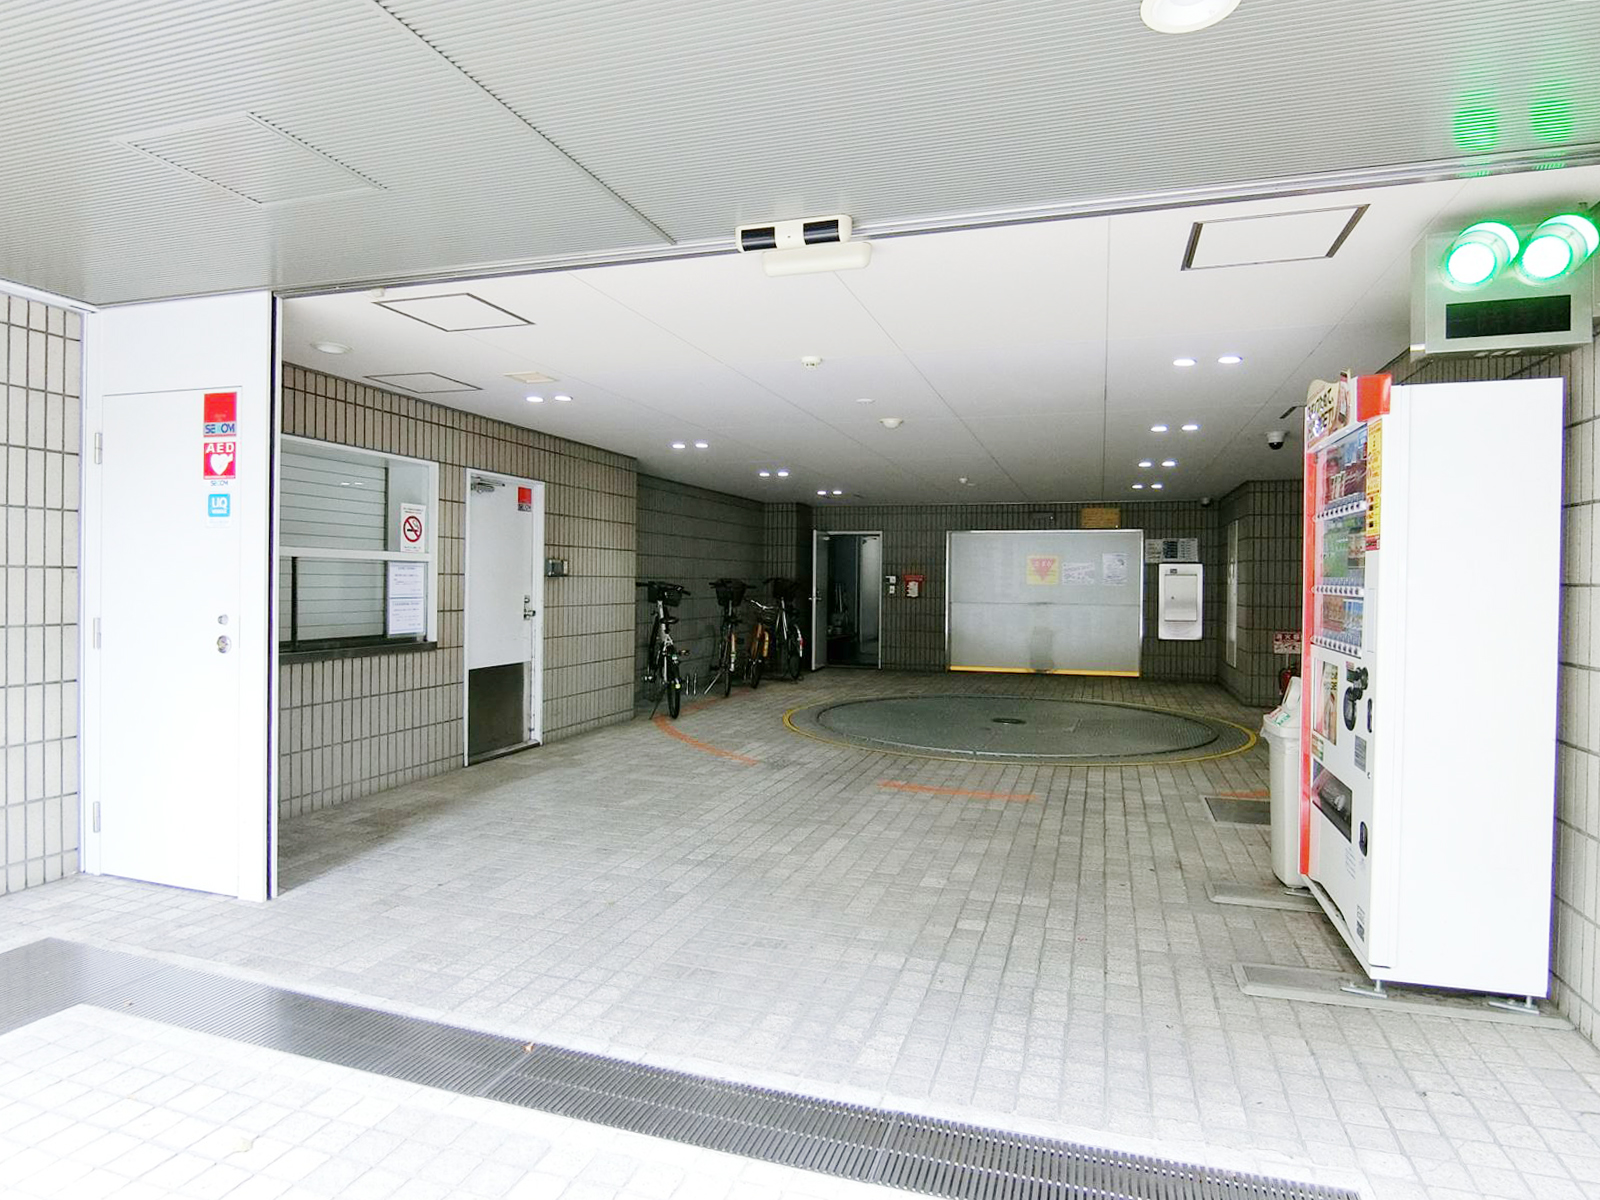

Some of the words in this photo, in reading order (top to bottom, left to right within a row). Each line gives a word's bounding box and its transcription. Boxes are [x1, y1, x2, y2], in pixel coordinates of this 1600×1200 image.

[204, 423, 235, 434] SEOM
[205, 442, 235, 454] AED
[211, 496, 228, 508] UQ
